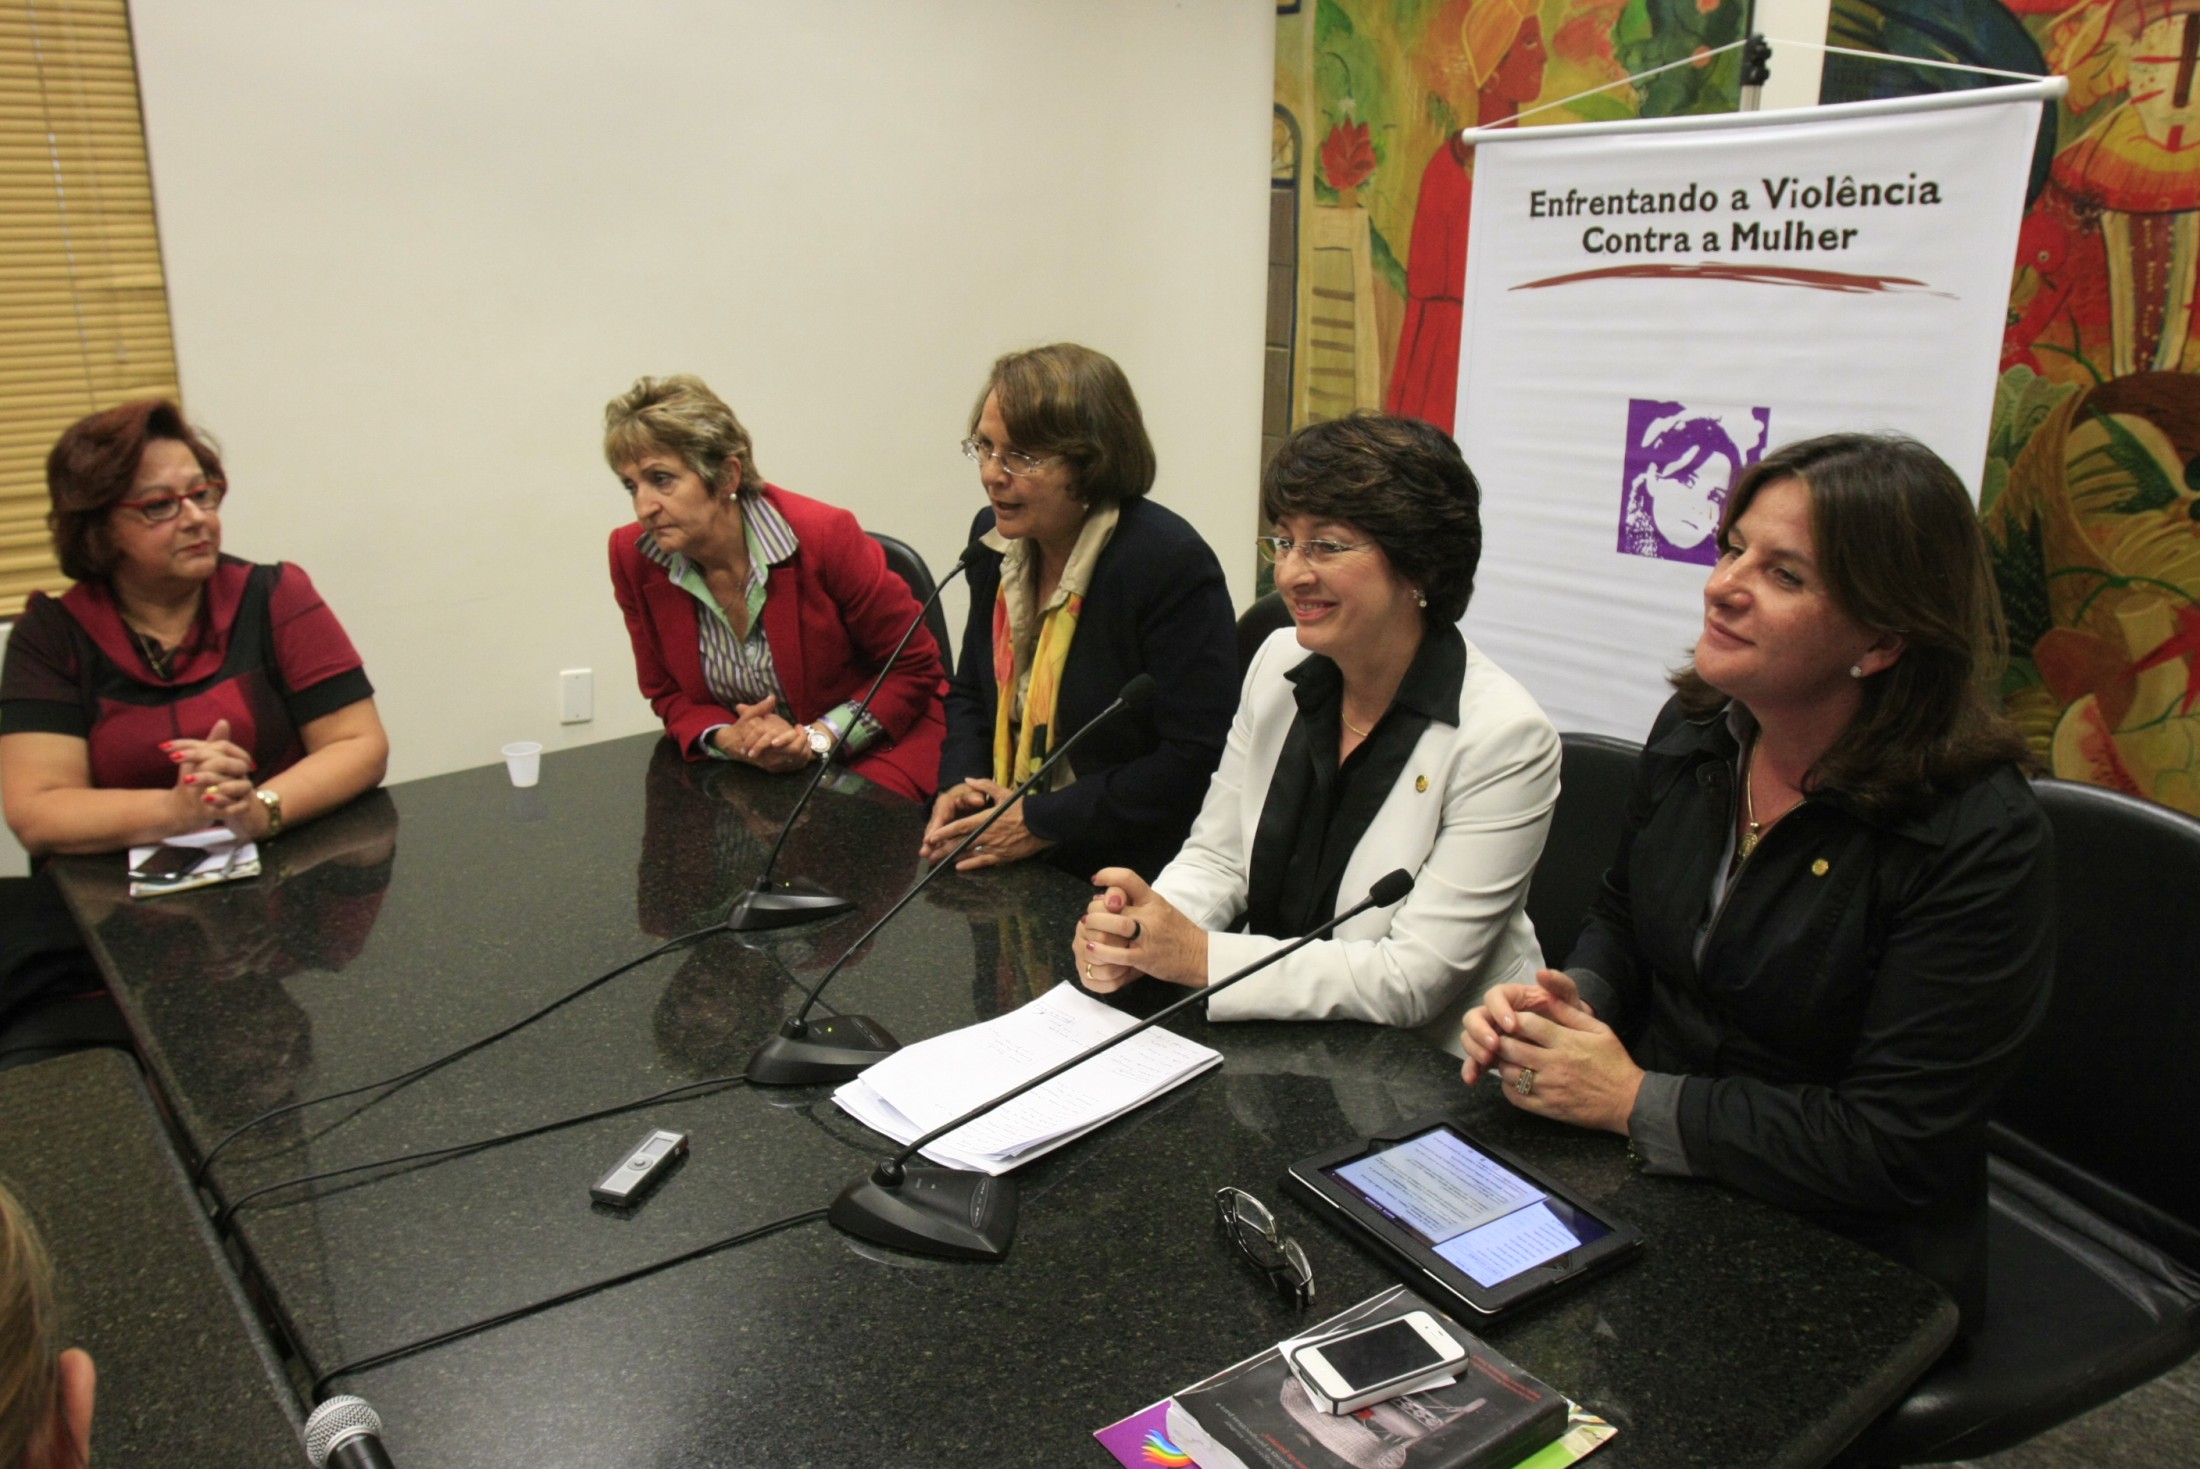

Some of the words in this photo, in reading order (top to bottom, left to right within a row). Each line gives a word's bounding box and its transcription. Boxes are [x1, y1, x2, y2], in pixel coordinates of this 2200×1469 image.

[1529, 182, 1718, 218] Enfrentando
[1731, 189, 1750, 211] a
[1762, 172, 1942, 210] Violência
[1582, 226, 1691, 254] Contra
[1702, 231, 1721, 252] a
[1731, 220, 1858, 252] Mulher
